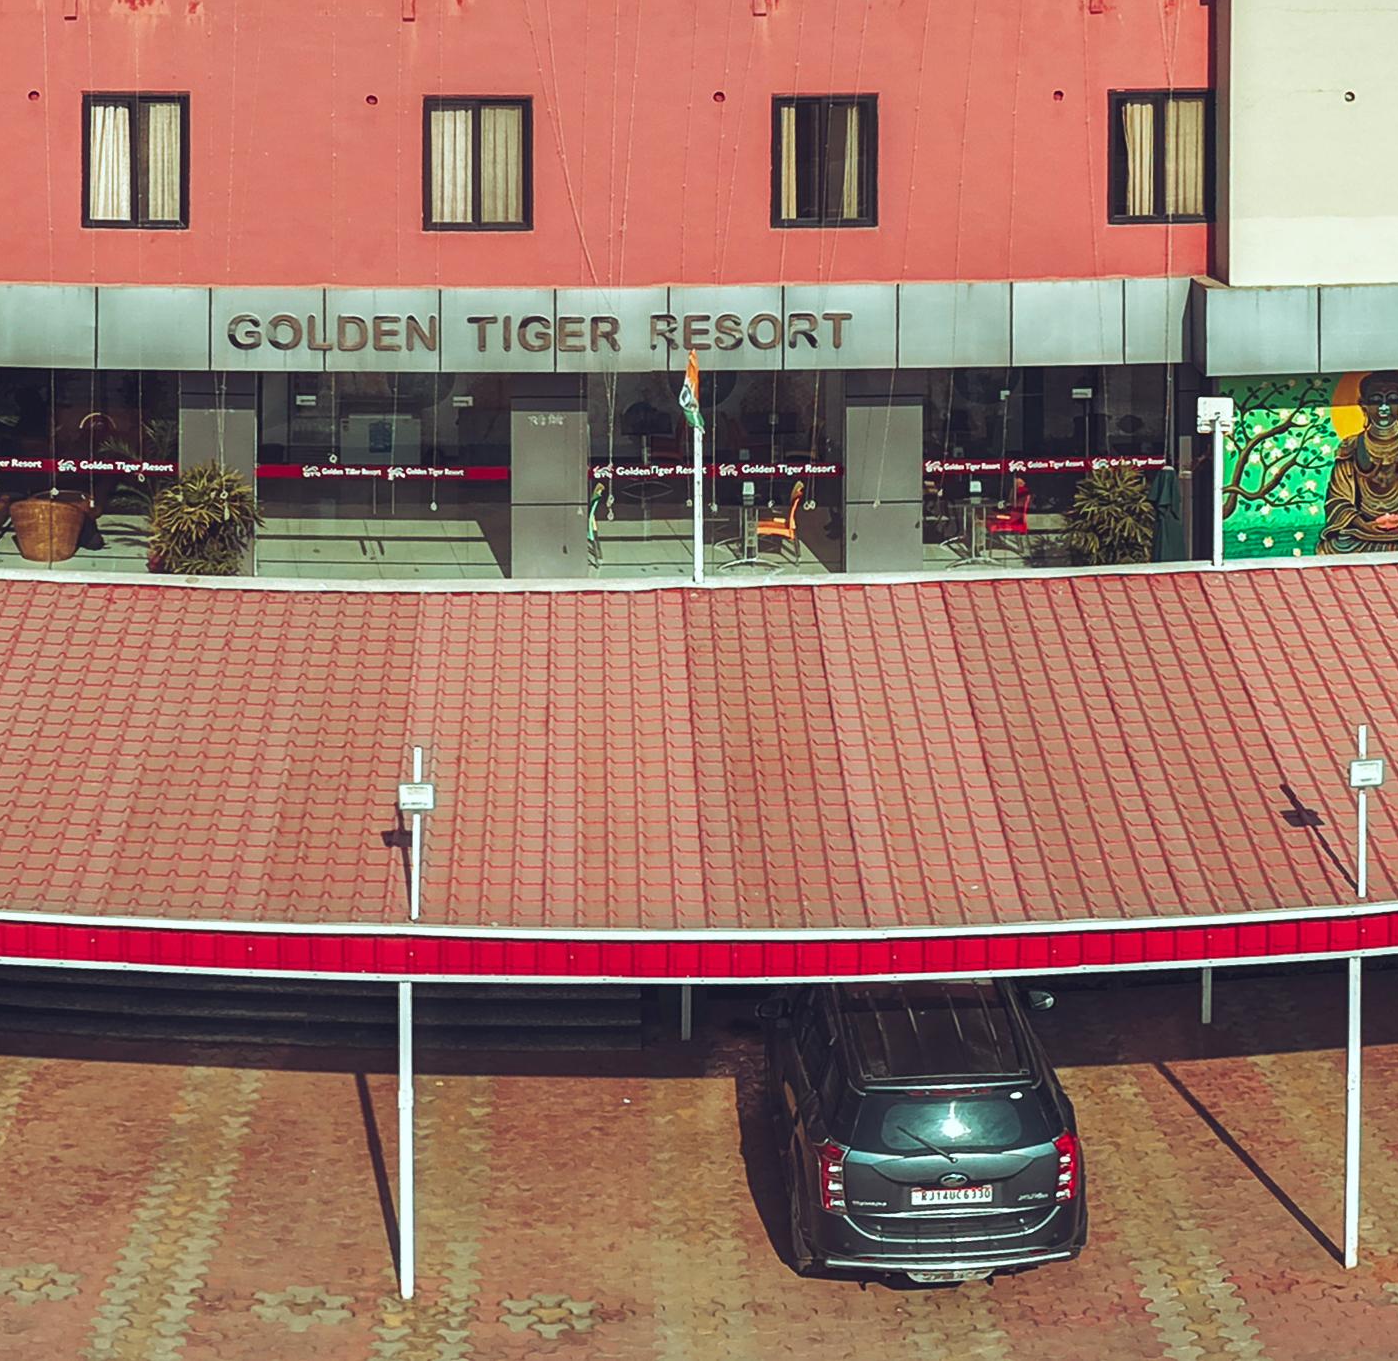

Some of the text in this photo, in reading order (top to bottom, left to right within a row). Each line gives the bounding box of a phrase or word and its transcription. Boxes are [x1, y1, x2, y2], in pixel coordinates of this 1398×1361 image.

[227, 312, 853, 352] GOLDEN TIGER RESORT
[11, 459, 42, 468] Resort
[79, 461, 114, 471] Golden
[116, 461, 141, 472] Tiger
[141, 462, 173, 472] Resort
[616, 466, 651, 476] Golden
[741, 464, 775, 474] Golden
[776, 465, 804, 475] Tiger
[804, 464, 836, 474] Resort
